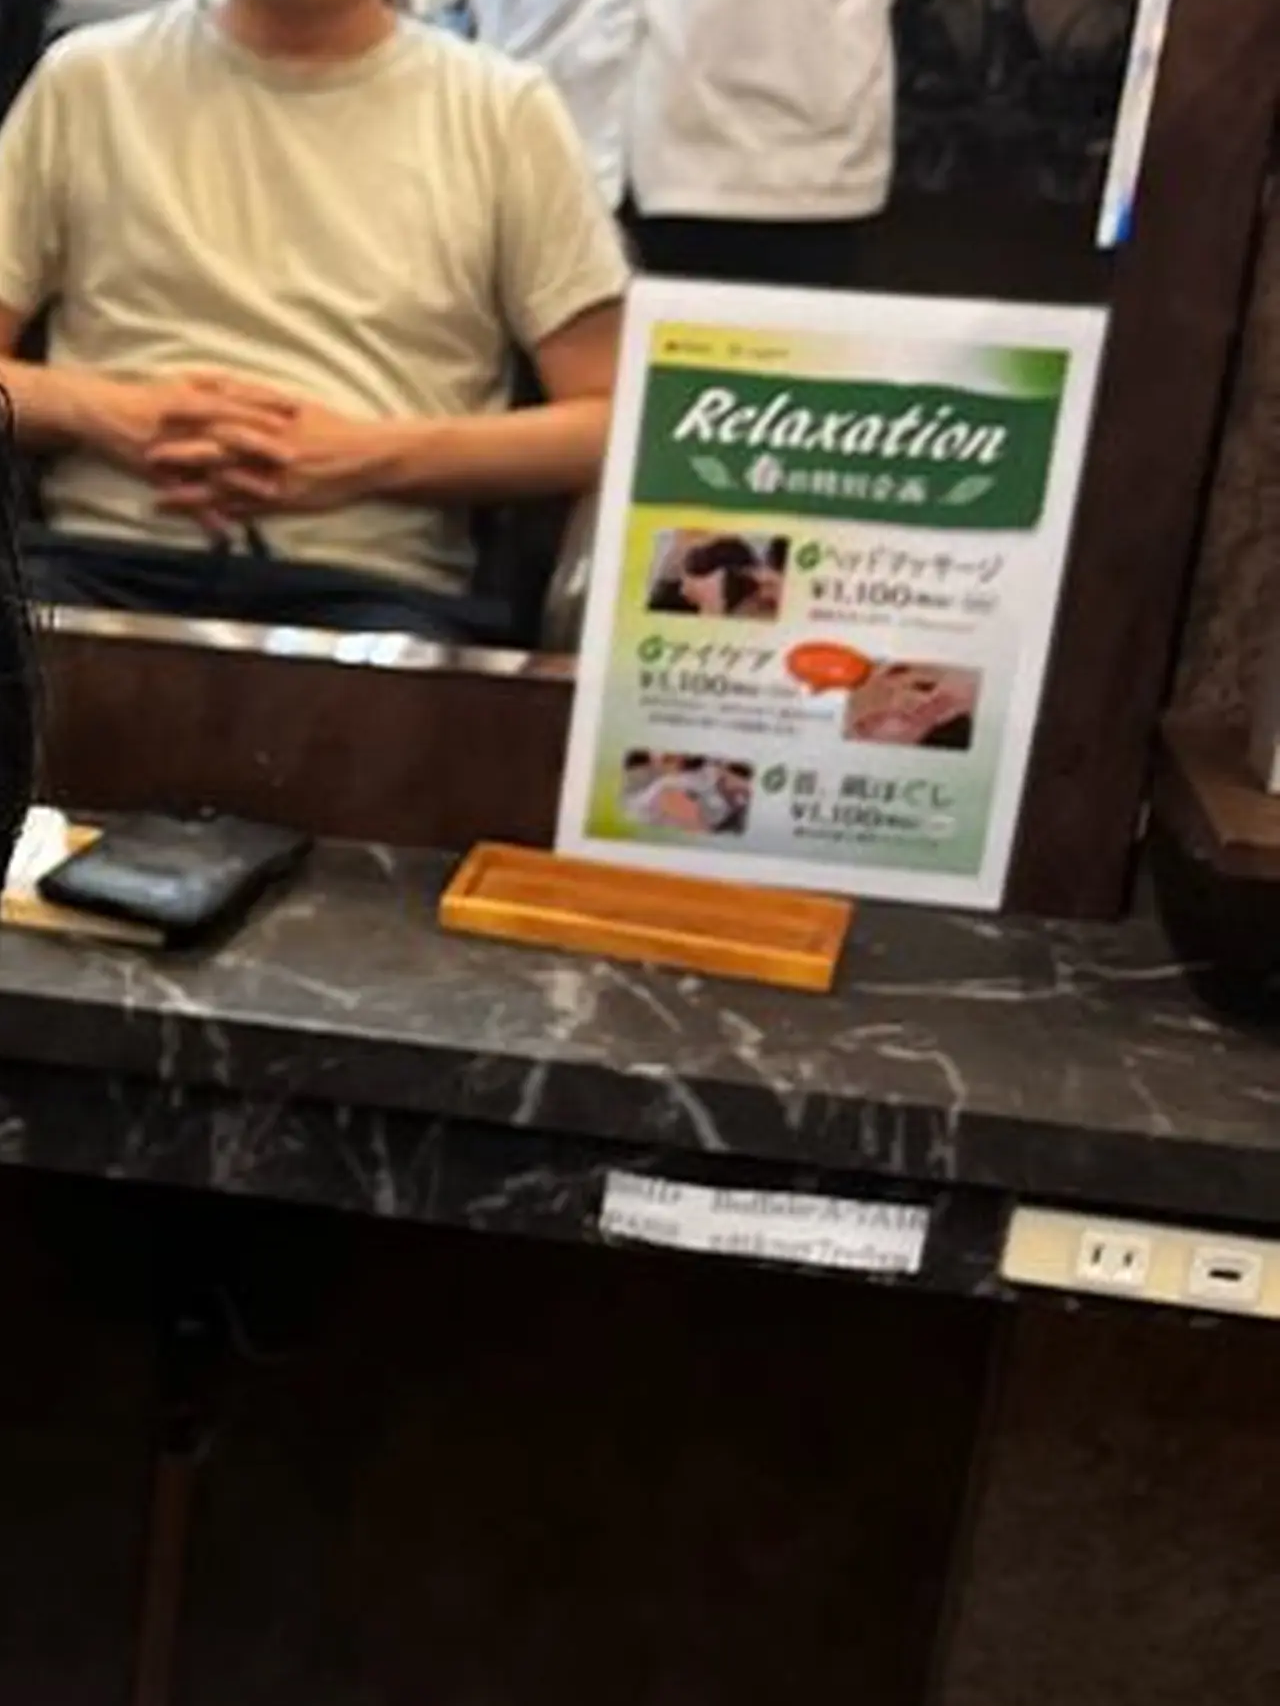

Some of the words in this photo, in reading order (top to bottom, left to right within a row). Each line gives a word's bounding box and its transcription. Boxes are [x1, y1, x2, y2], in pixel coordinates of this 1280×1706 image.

[673, 386, 1008, 464] Relaxation
[668, 641, 777, 672] アイケア
